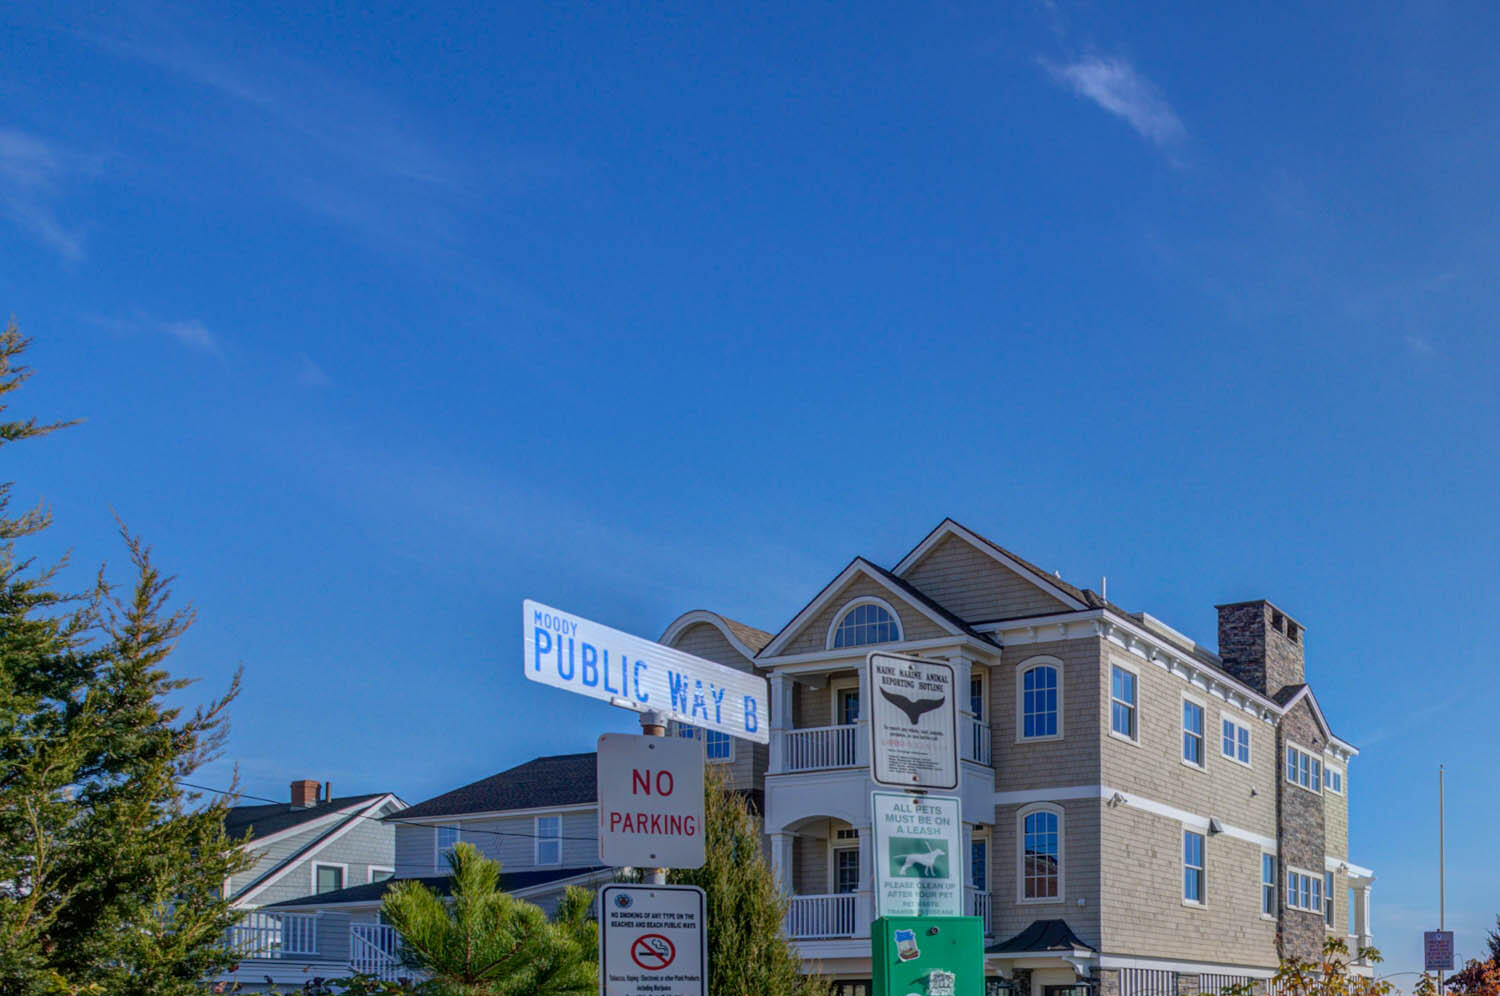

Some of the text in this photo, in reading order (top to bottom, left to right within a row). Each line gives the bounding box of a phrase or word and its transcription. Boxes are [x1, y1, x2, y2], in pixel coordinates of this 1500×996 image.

[534, 610, 578, 637] MOODY
[534, 627, 758, 733] PUBLIC WAY B
[876, 666, 896, 676] MAINE
[926, 673, 949, 684] ANIMAL
[882, 676, 914, 688] REPORTING
[632, 768, 674, 797] NO
[893, 803, 942, 815] ALL PETS
[610, 812, 695, 836] PARKING
[885, 814, 951, 826] MUST BE ON
[896, 825, 941, 835] A LEASH
[884, 881, 914, 889] PLEASE
[916, 881, 943, 889] CLEAN
[663, 912, 676, 920] TYPE
